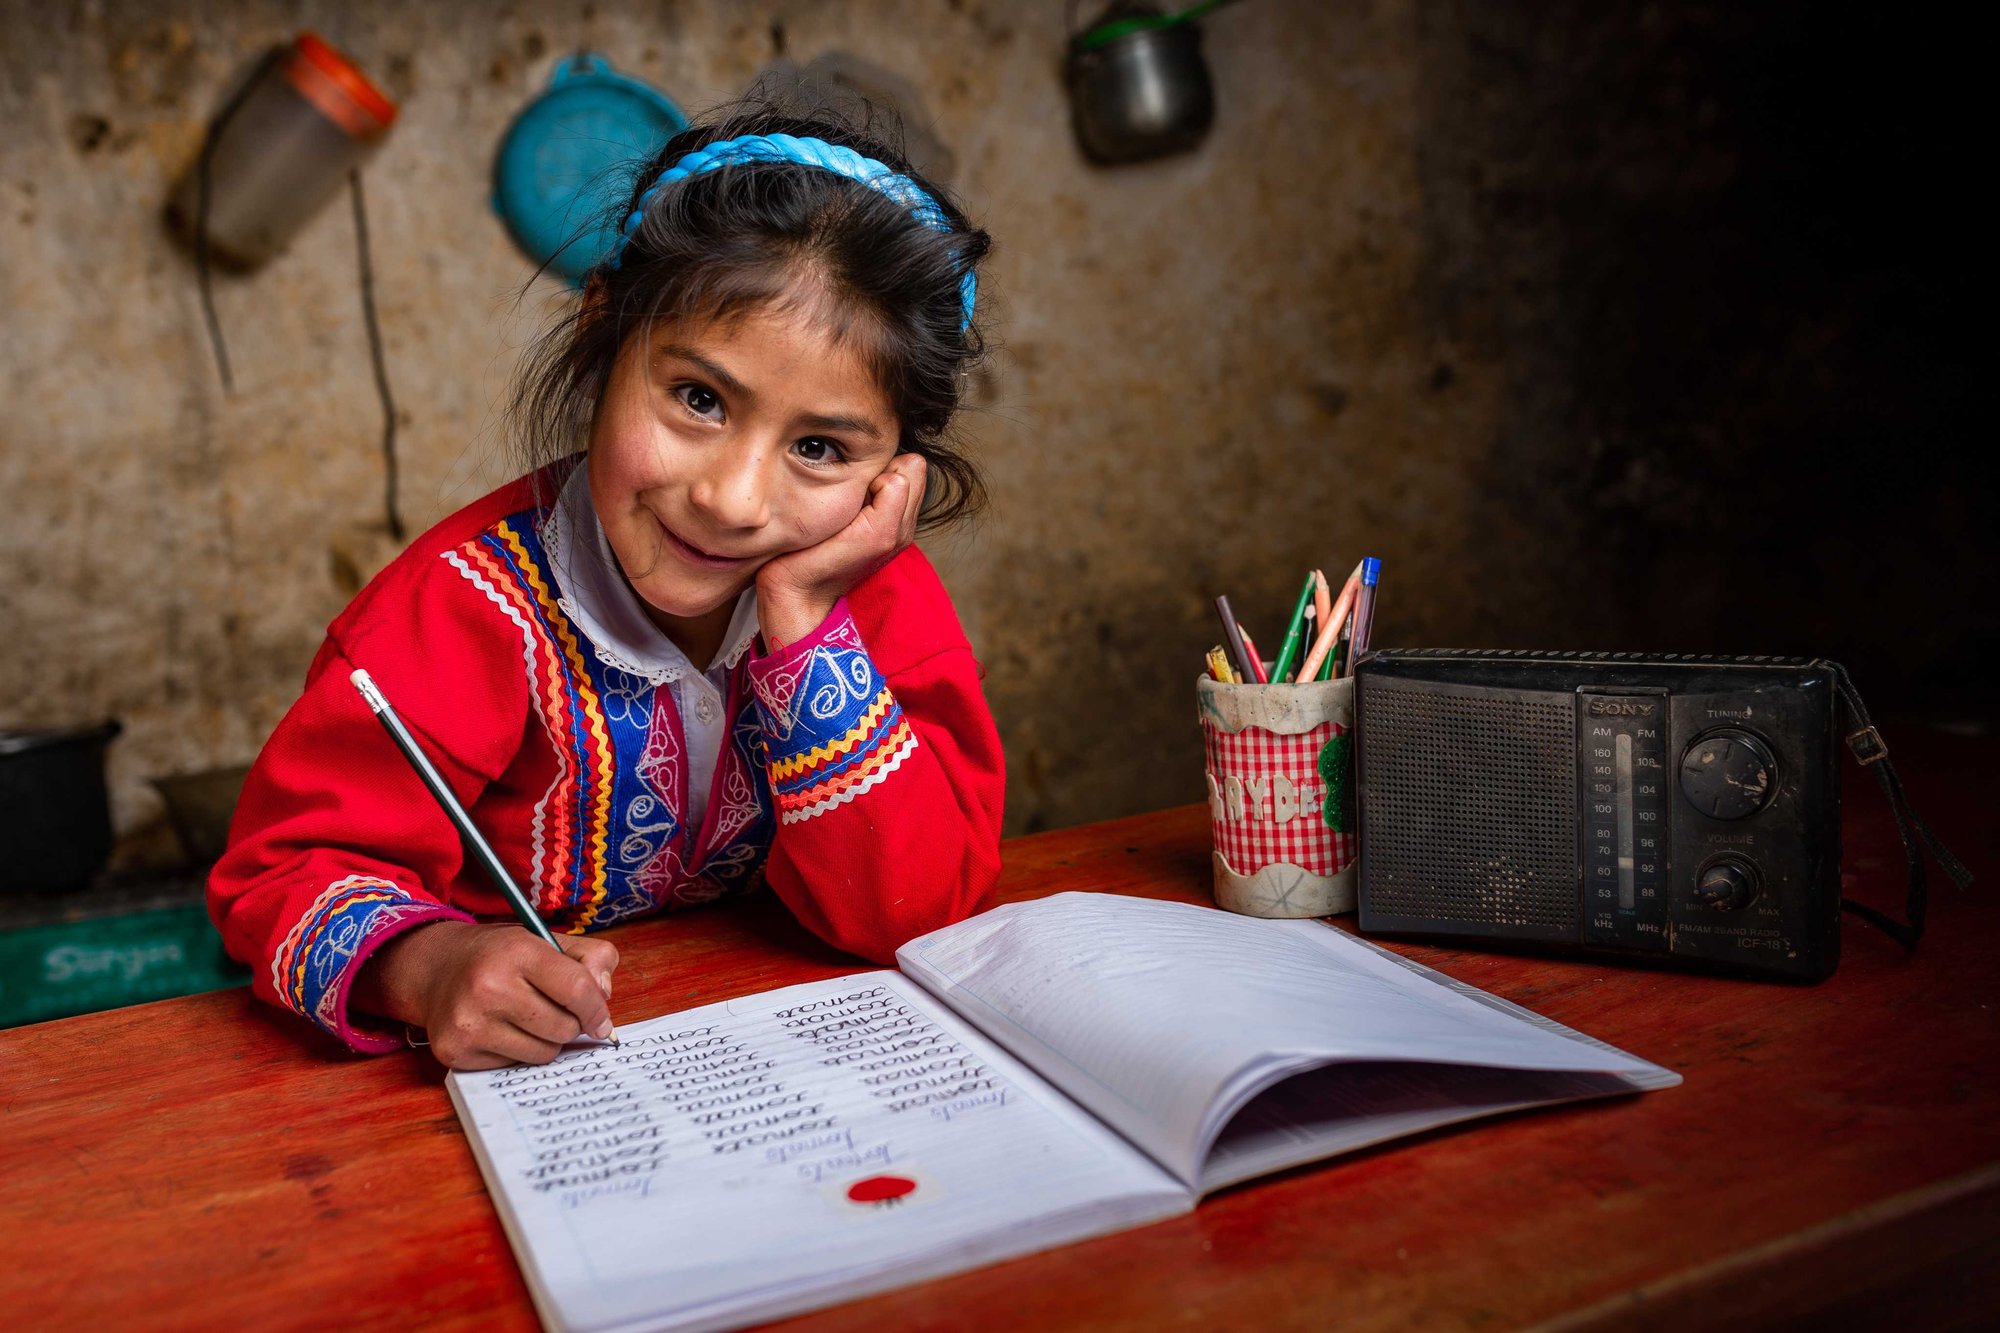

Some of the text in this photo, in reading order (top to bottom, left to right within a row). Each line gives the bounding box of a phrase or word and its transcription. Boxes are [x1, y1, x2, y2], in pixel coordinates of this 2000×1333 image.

[1590, 702, 1655, 717] SONY
[1707, 709, 1753, 719] TUNING
[1593, 728, 1612, 737] AM
[1637, 729, 1656, 739] FM
[1594, 748, 1611, 758] 160
[1638, 757, 1656, 766] 108
[1594, 766, 1612, 775] 140
[1594, 783, 1611, 793] 120
[1639, 785, 1656, 795] 104
[1595, 804, 1612, 814] 100
[1639, 811, 1656, 821] 100
[1597, 829, 1611, 839] 80
[1641, 838, 1655, 848] 96
[1707, 834, 1754, 845] VOLUME
[1598, 846, 1611, 855] 70
[1597, 866, 1611, 876] 60
[1641, 864, 1655, 873] 92
[1598, 888, 1611, 898] 53
[1641, 887, 1655, 897] 88
[1758, 907, 1780, 917] MAX
[1594, 919, 1613, 929] kHz
[1637, 923, 1659, 933] MHz
[1679, 924, 1711, 934] FM/AM
[1750, 929, 1780, 938] RADIO
